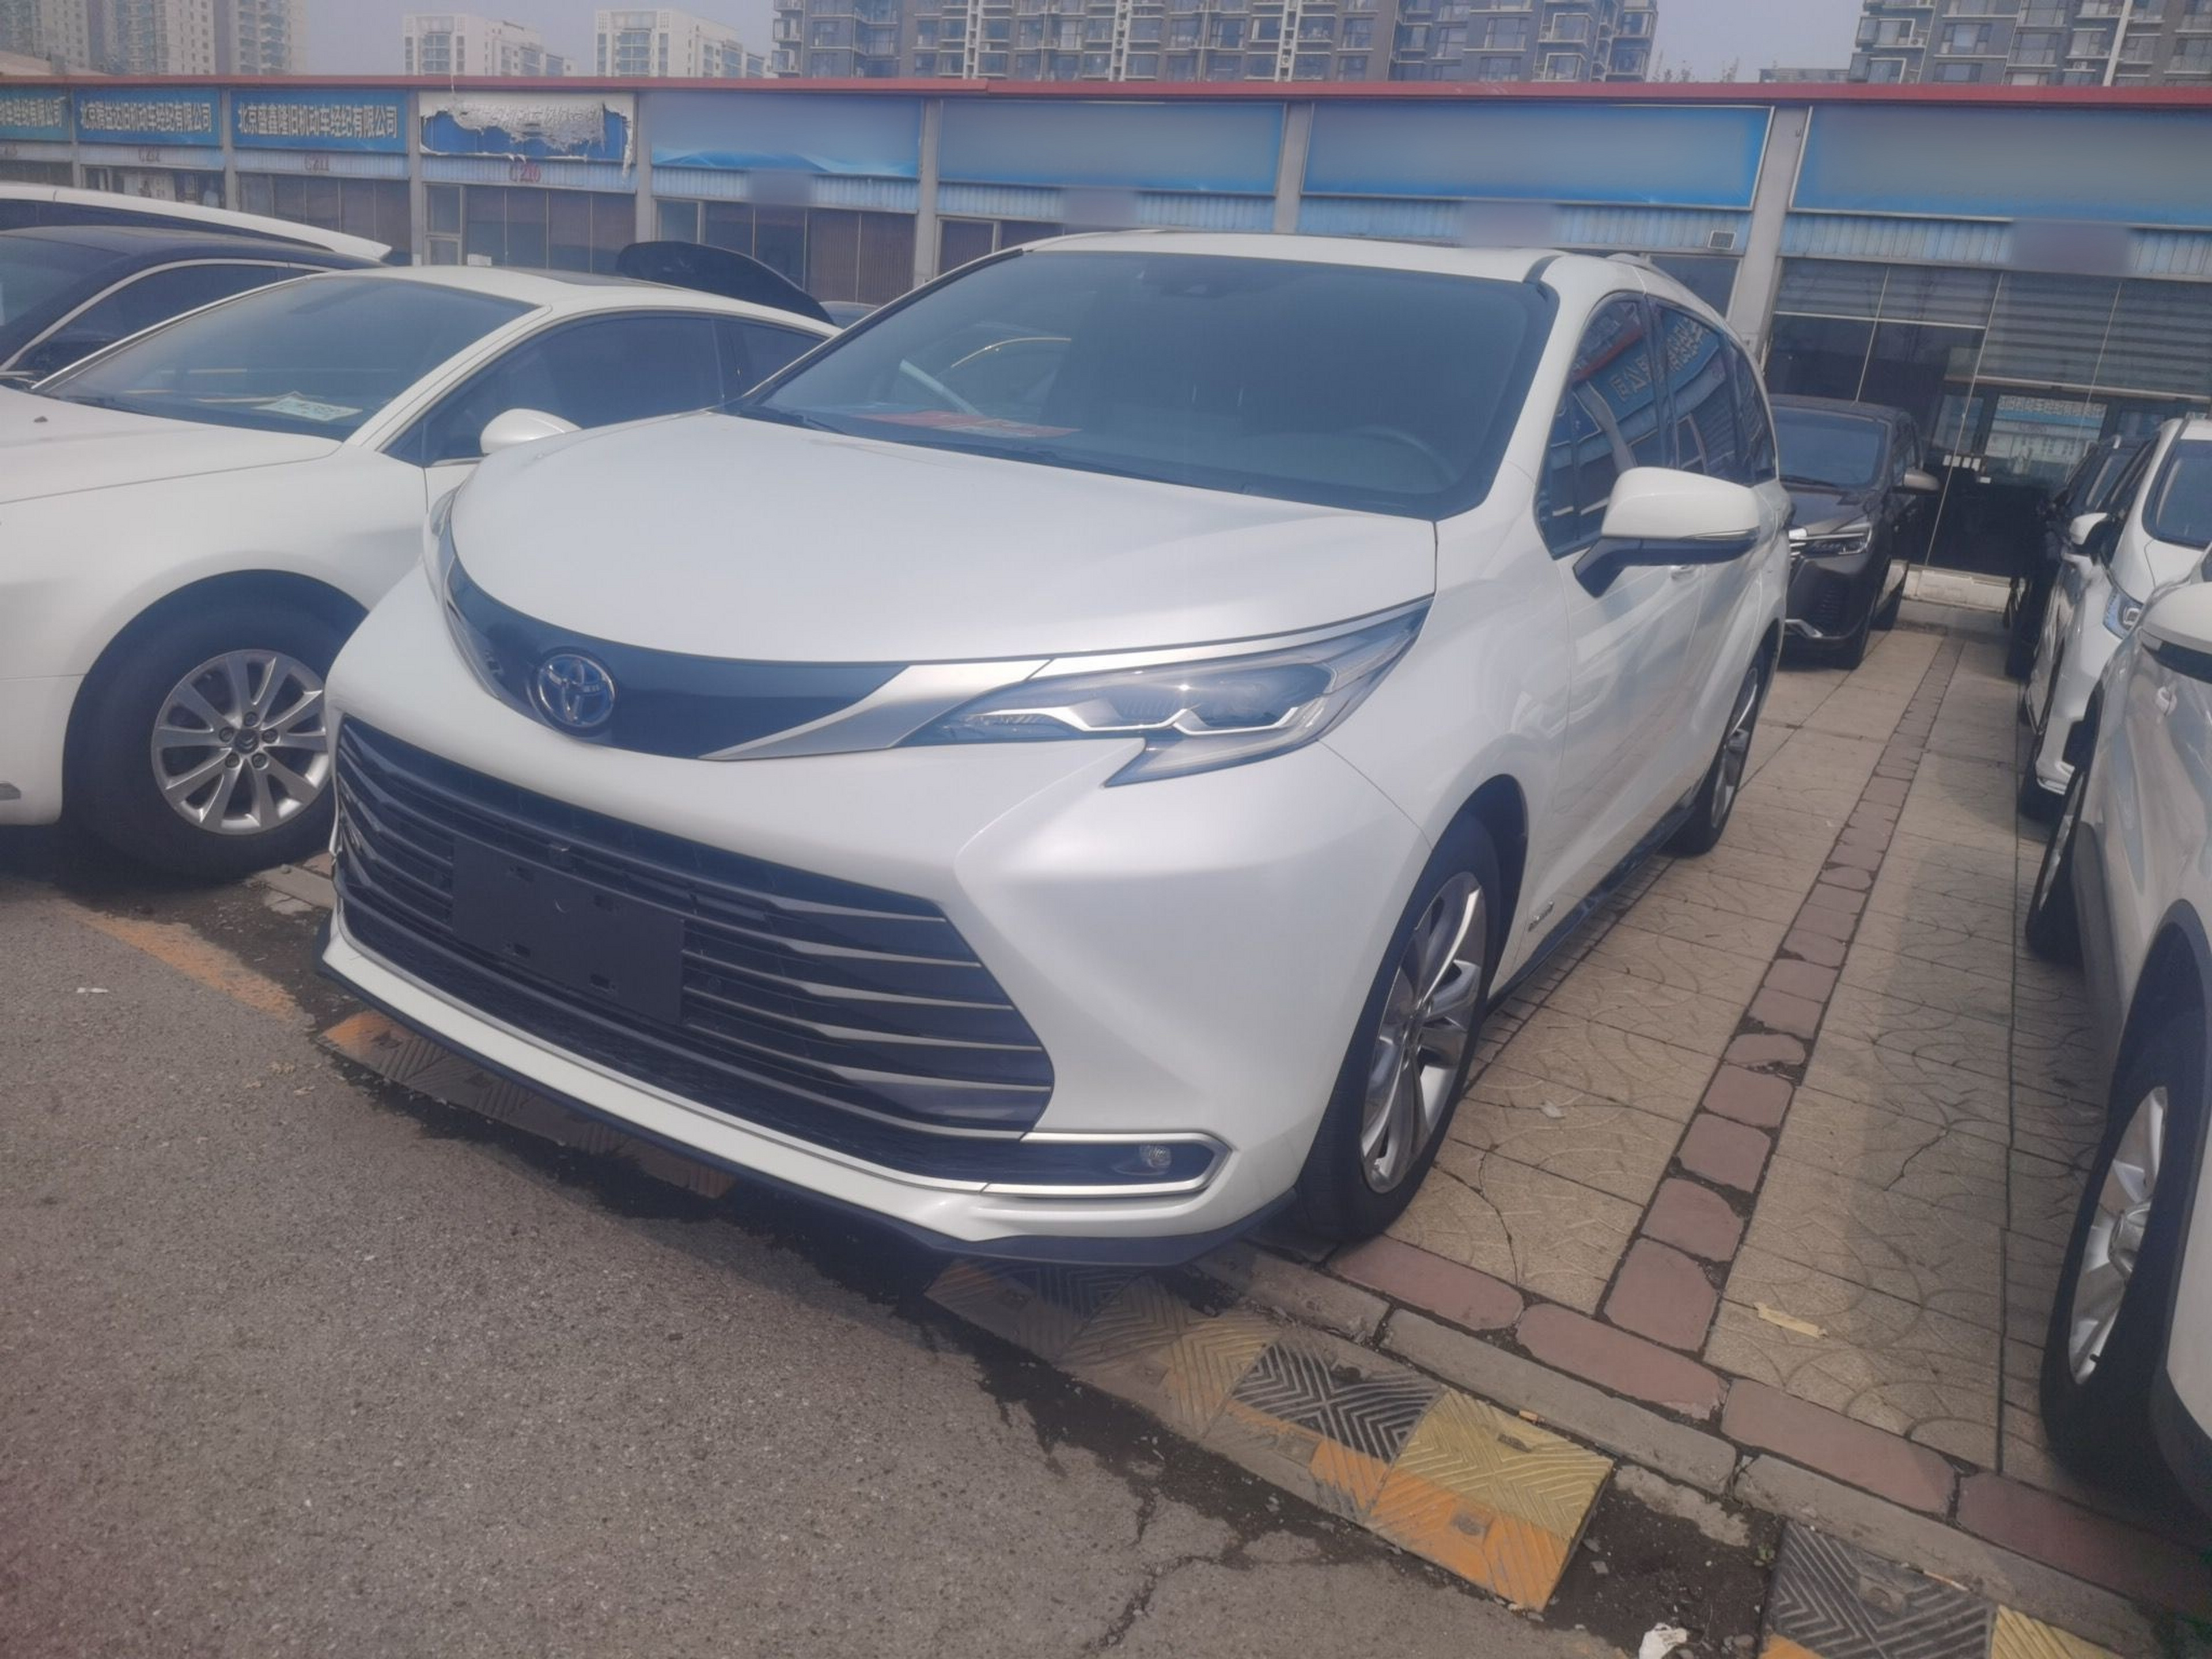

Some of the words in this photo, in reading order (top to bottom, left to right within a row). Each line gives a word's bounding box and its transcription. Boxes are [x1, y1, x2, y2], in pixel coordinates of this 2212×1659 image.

[238, 103, 397, 139] 北京盛鑫隆旧机动车经纪有限公司
